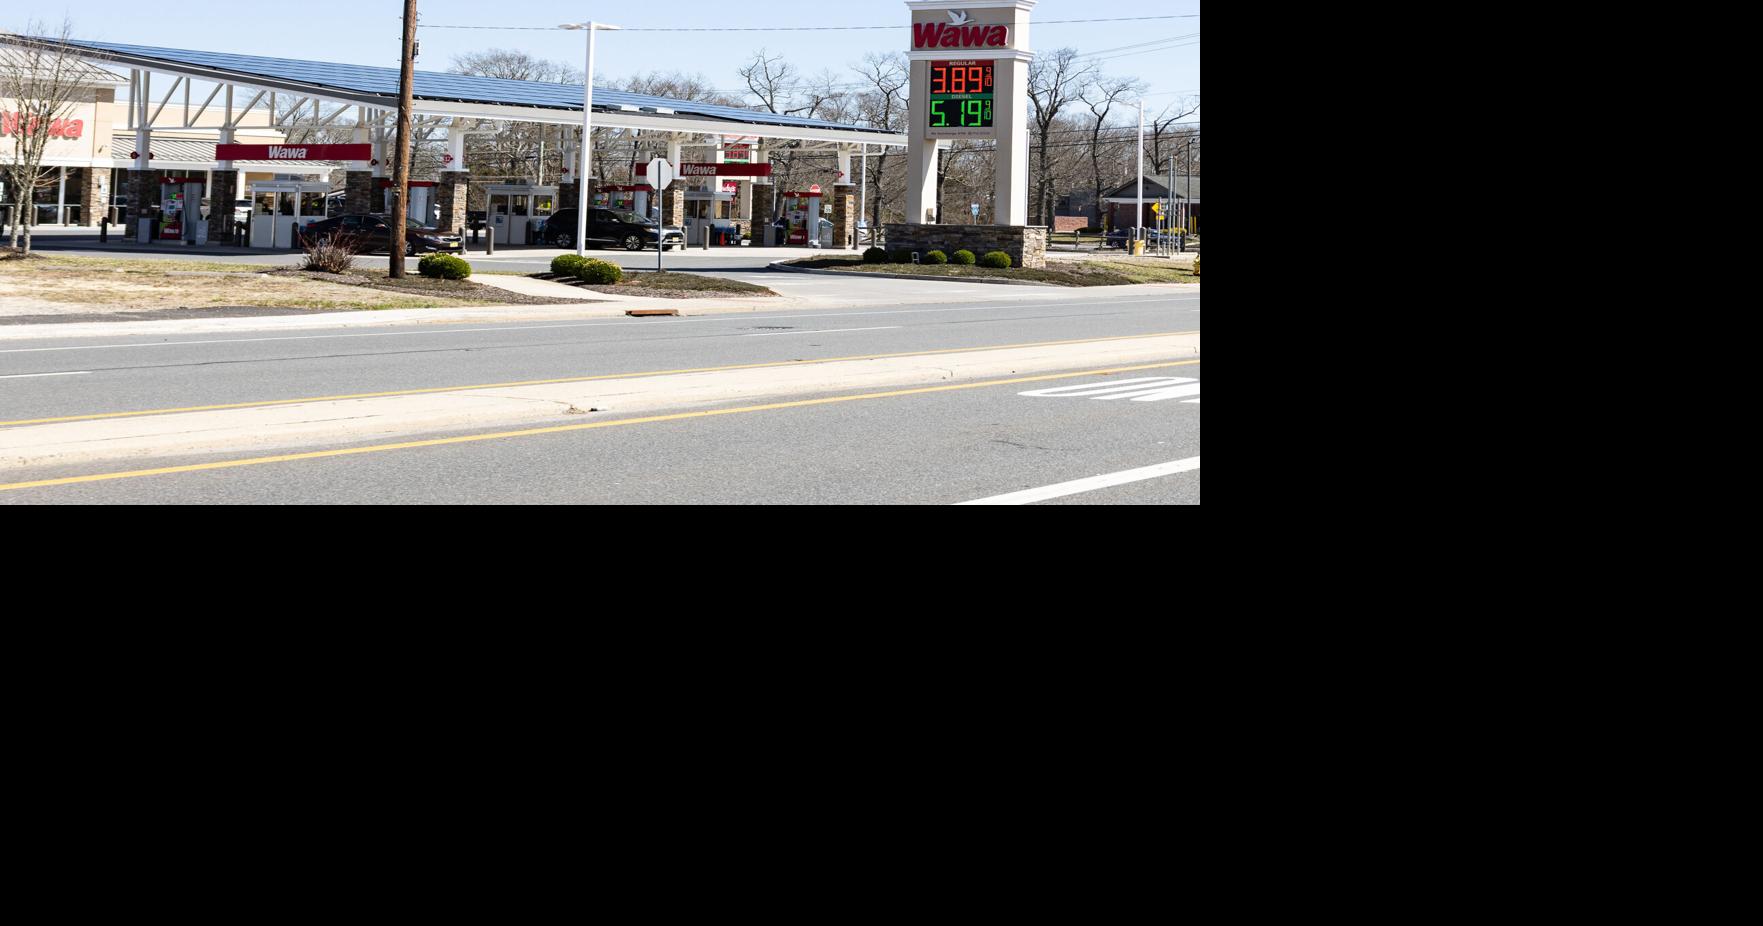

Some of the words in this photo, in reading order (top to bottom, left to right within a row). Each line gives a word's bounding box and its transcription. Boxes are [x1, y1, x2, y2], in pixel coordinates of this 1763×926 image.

[914, 23, 1008, 48] Wawa
[932, 67, 983, 93] 3.89
[931, 100, 982, 127] 5.19
[268, 145, 307, 159] Wawa
[682, 163, 717, 175] Wawa
